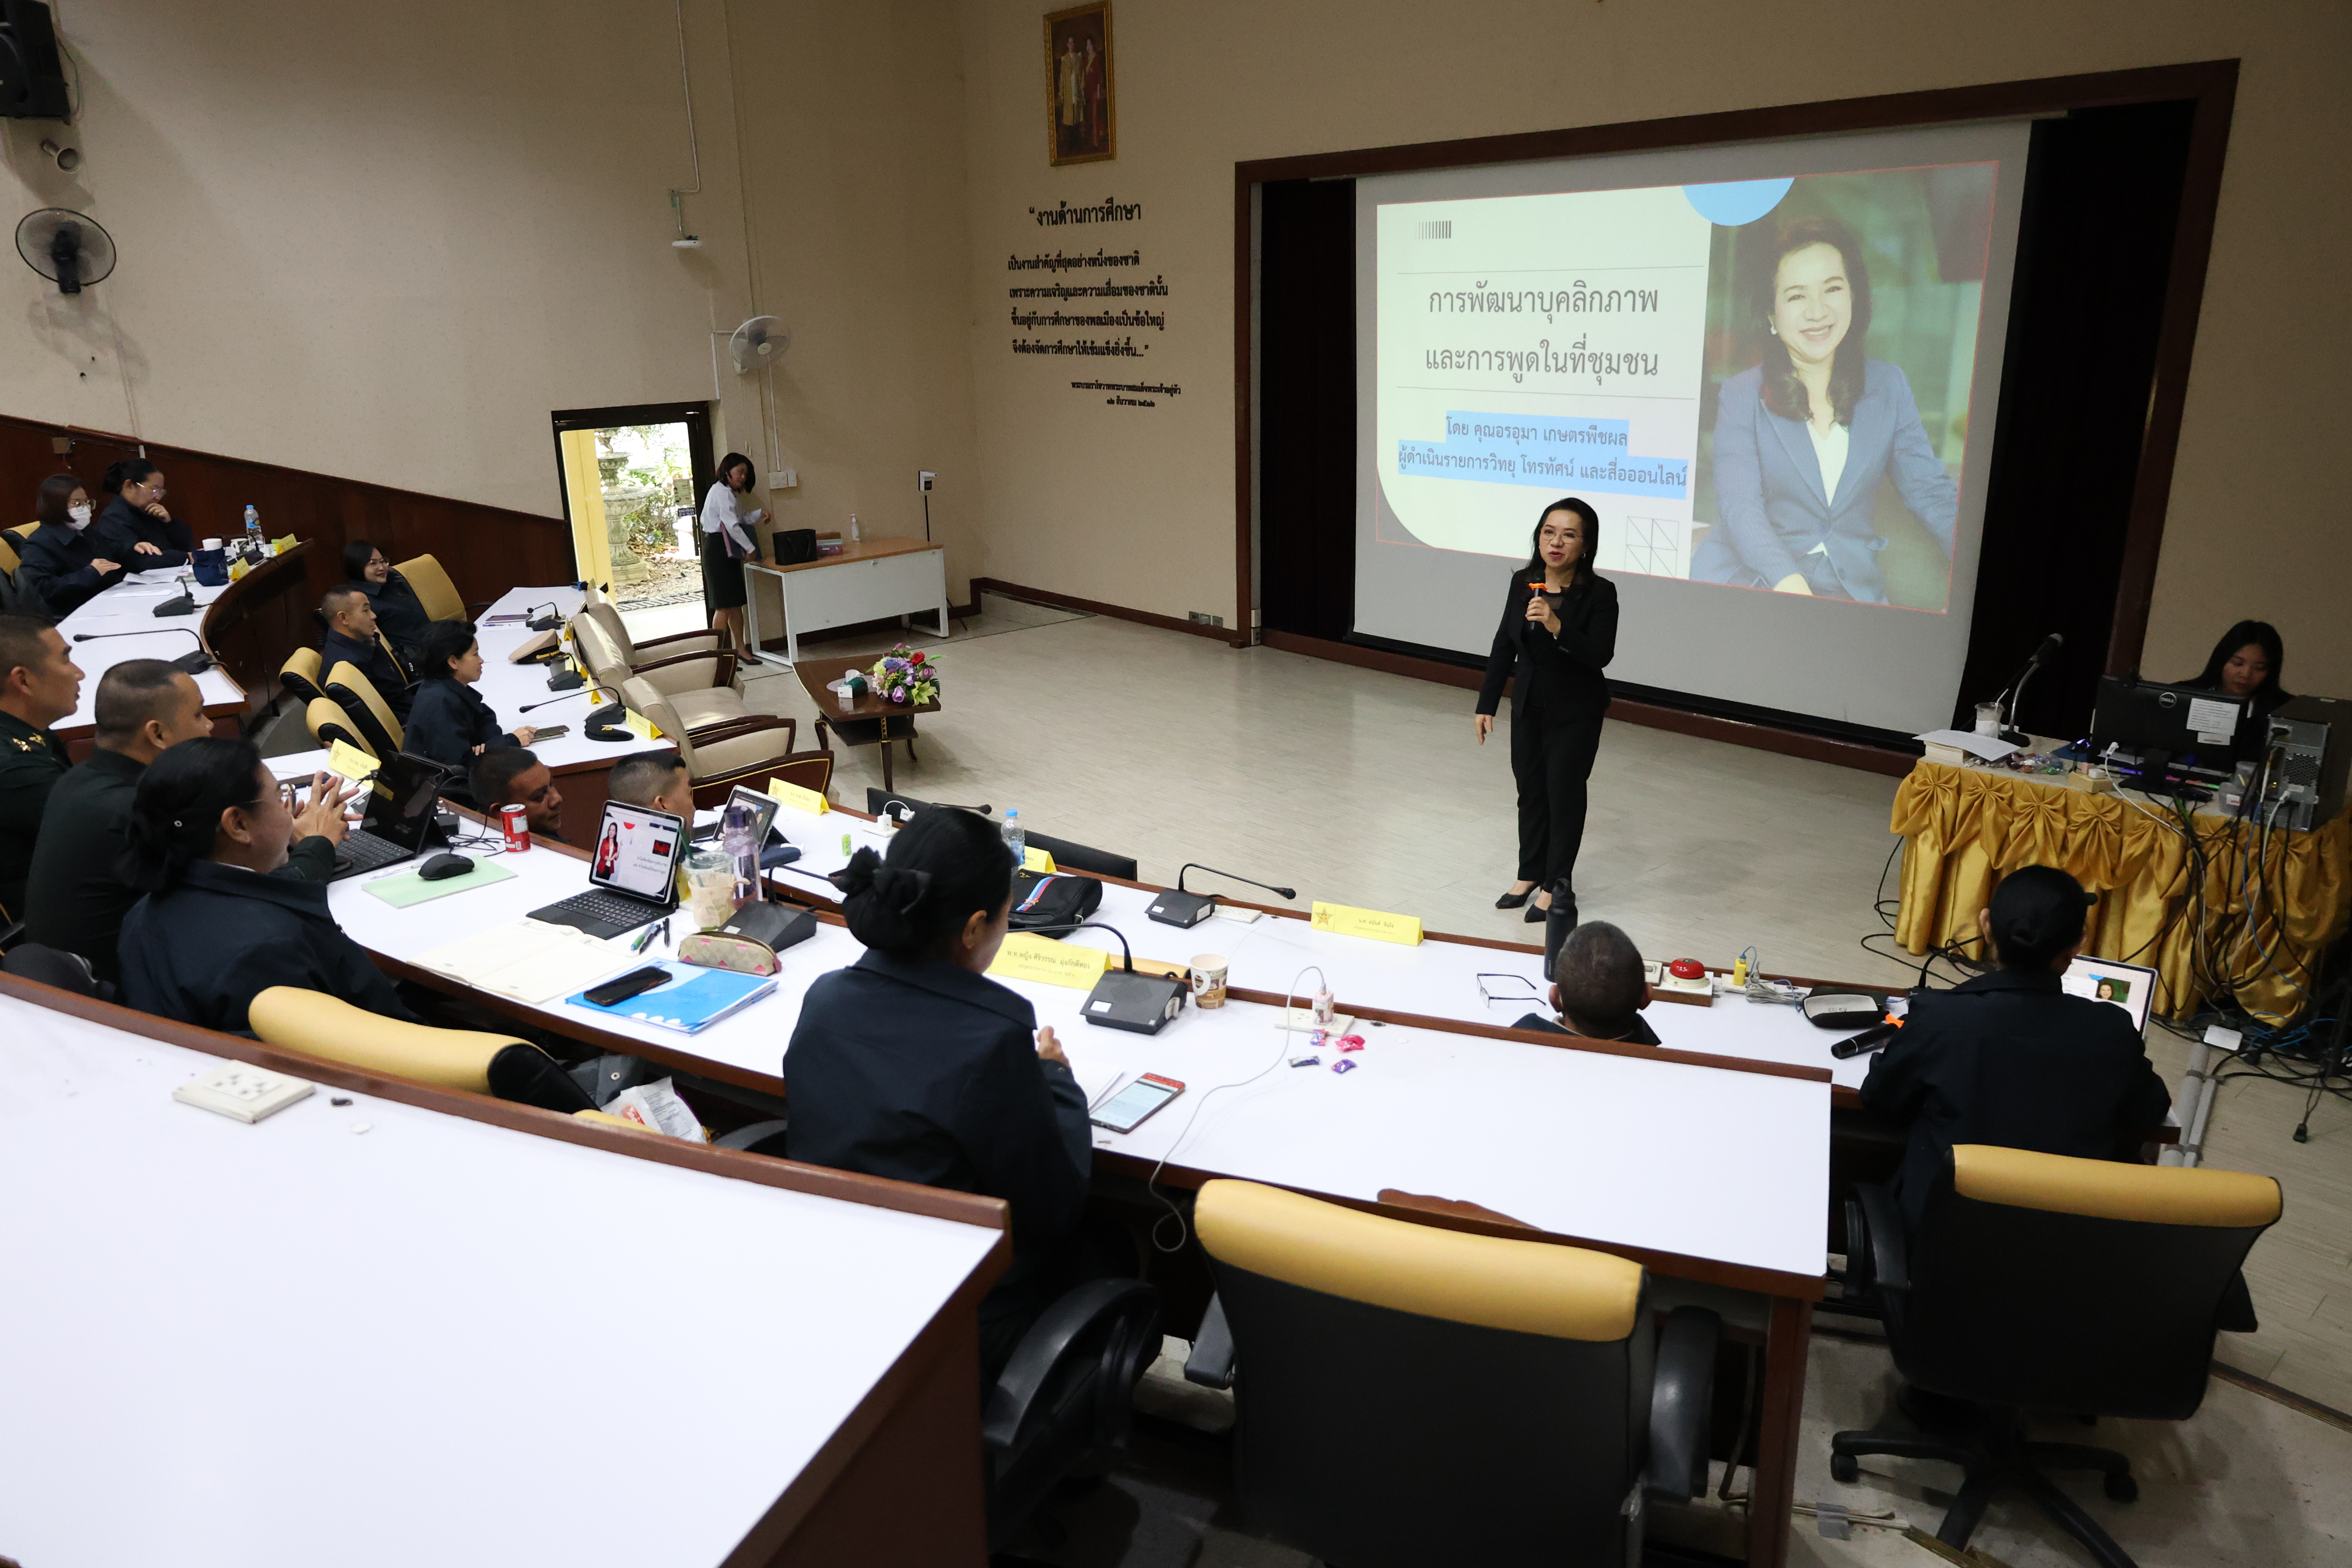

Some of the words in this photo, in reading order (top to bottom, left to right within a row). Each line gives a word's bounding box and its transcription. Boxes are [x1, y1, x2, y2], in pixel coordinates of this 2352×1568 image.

[1430, 279, 1658, 324] การพัฒนาบุคลิกภาพ
[1426, 333, 1658, 385] และการพูดในที่ชุมชน
[1446, 416, 1469, 435] โดย
[1474, 424, 1537, 445] คุณอรอุมา
[1544, 425, 1627, 446] เกษตรพืชผล
[1399, 445, 1515, 478] ผู้ดำเนินรายการวิทยุ
[1521, 454, 1574, 477] โทรทัศน์
[1581, 457, 1687, 486] และสื่อออนไลน์
[1007, 950, 1031, 960] พ.ท.หญิง
[1034, 953, 1056, 964] ศิริวรรณ
